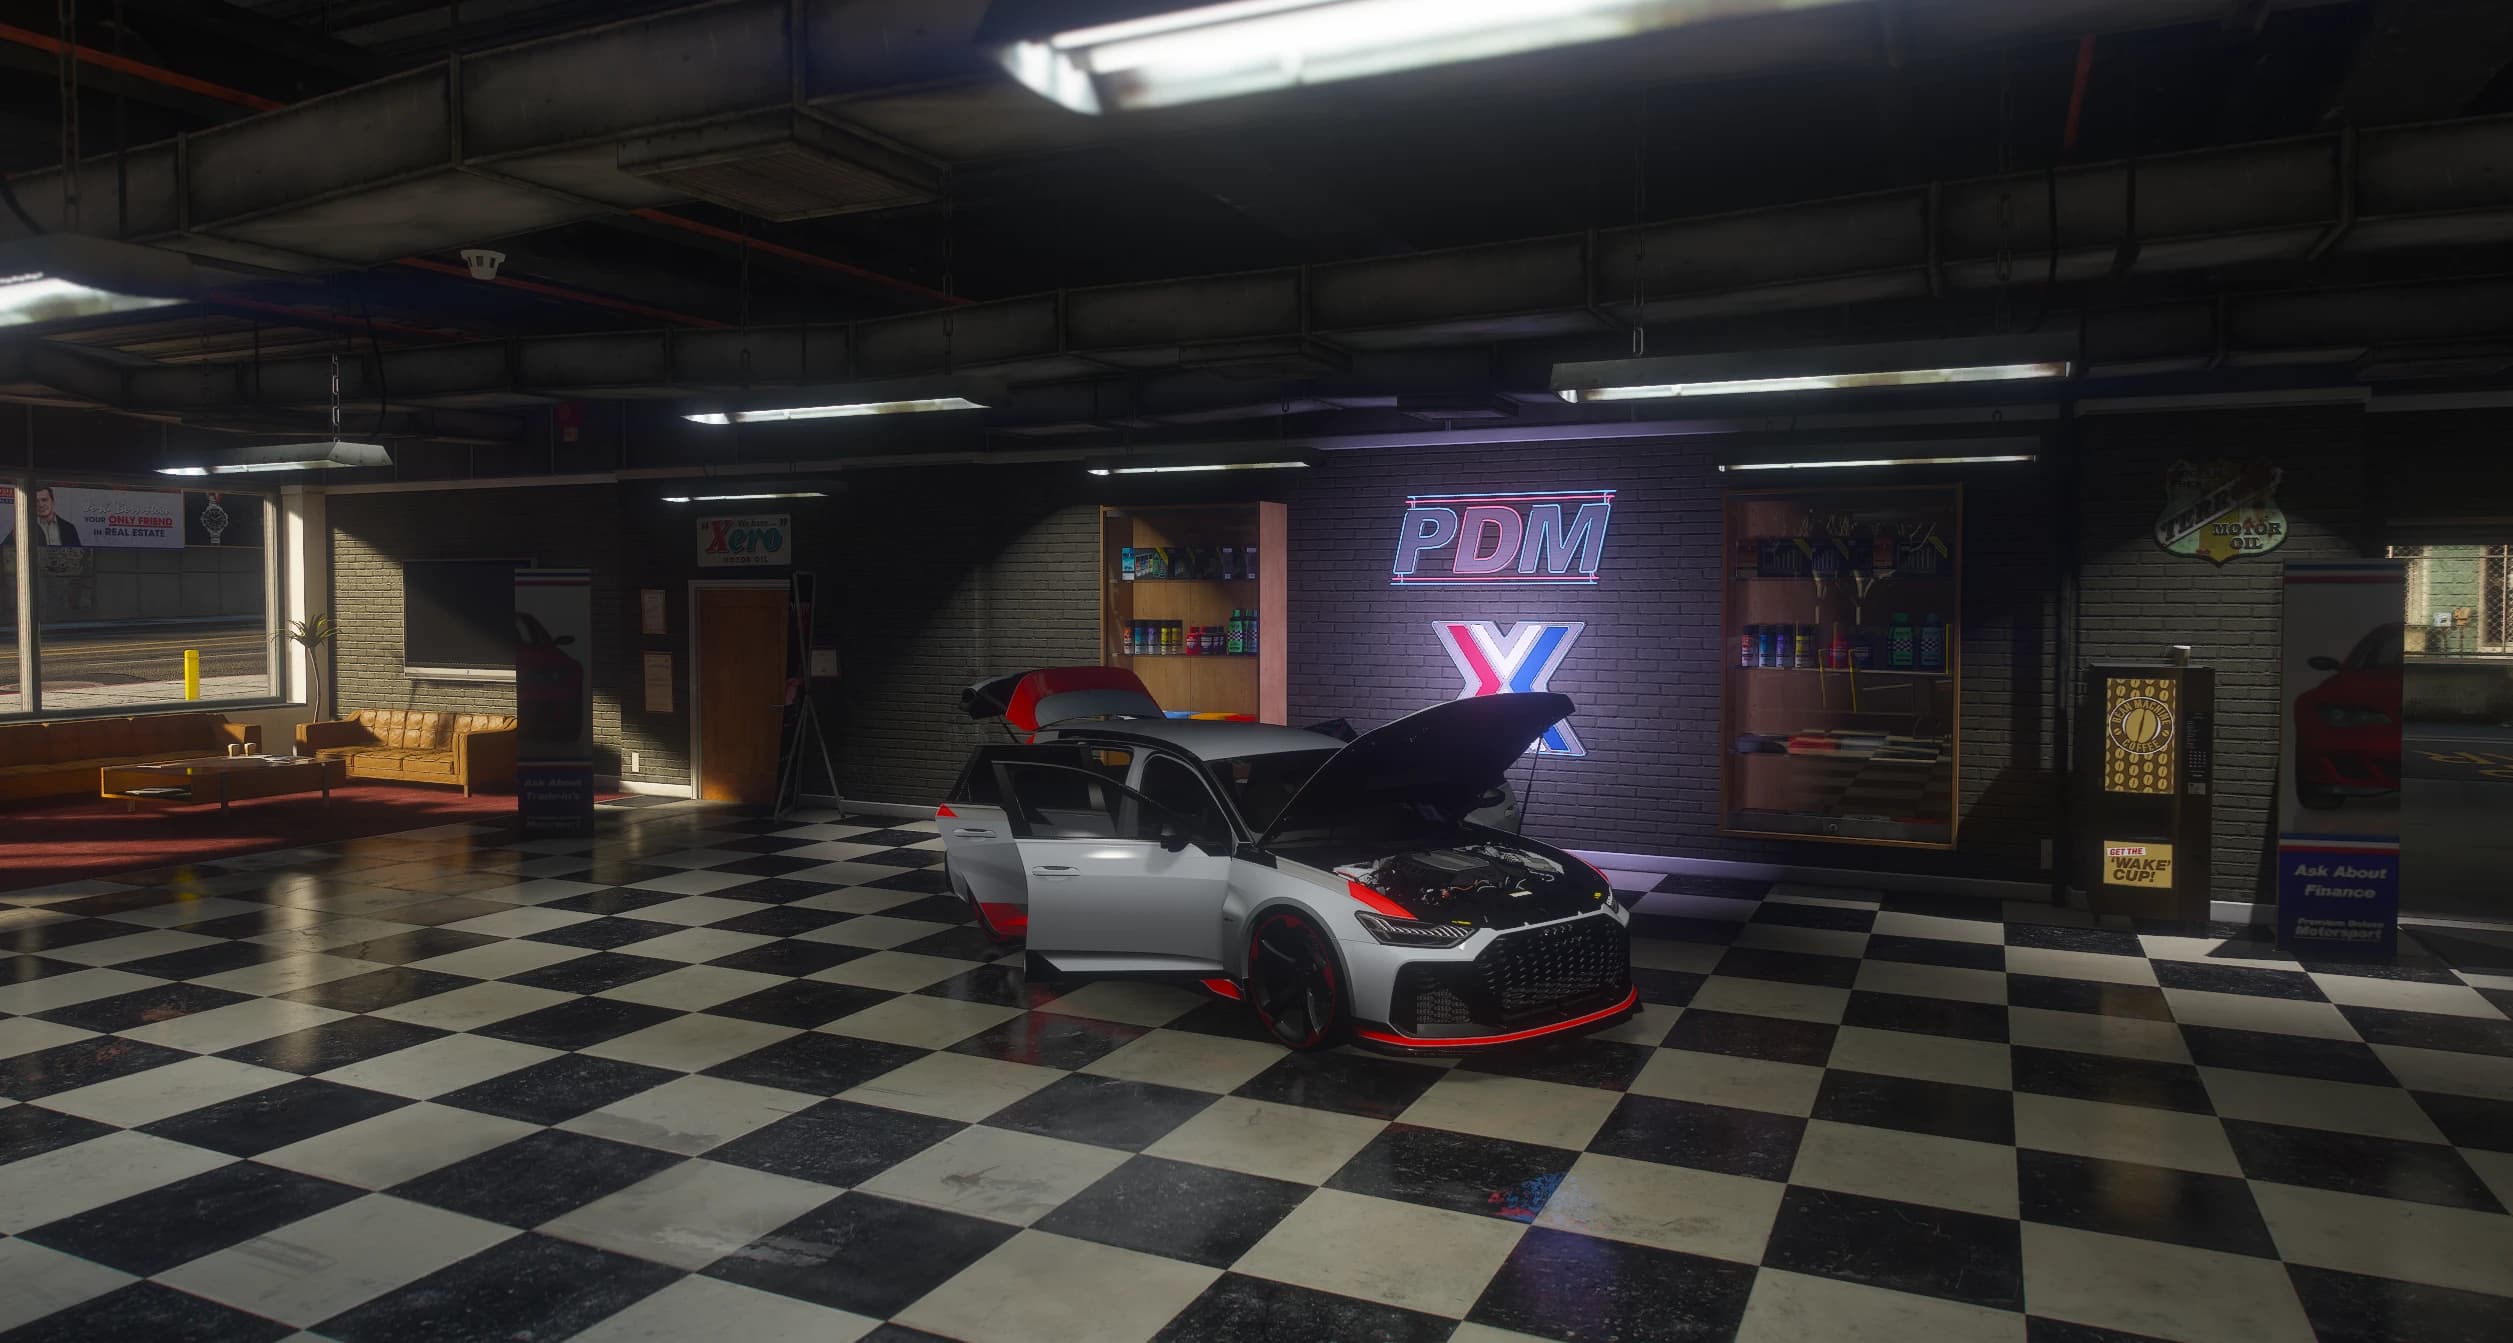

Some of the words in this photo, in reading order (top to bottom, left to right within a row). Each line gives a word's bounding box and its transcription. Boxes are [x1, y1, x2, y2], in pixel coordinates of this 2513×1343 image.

[109, 516, 135, 524] ONLY
[138, 517, 173, 525] FRIEND
[105, 528, 129, 536] REAL
[132, 529, 166, 537] ESTATE
[2212, 522, 2281, 536] MOTOR
[705, 519, 783, 554] Xero
[1392, 503, 1612, 575] PDM
[2230, 537, 2263, 549] OIL
[2112, 702, 2132, 723] BEAN
[2133, 699, 2171, 725] MACHINE
[2122, 740, 2160, 752] COFFEE
[2110, 848, 2125, 856] GET
[2127, 847, 2144, 855] THE
[2113, 868, 2156, 883] CUP!
[2293, 863, 2329, 877] Ask
[2333, 865, 2388, 880] About
[2303, 883, 2377, 899] Finance
